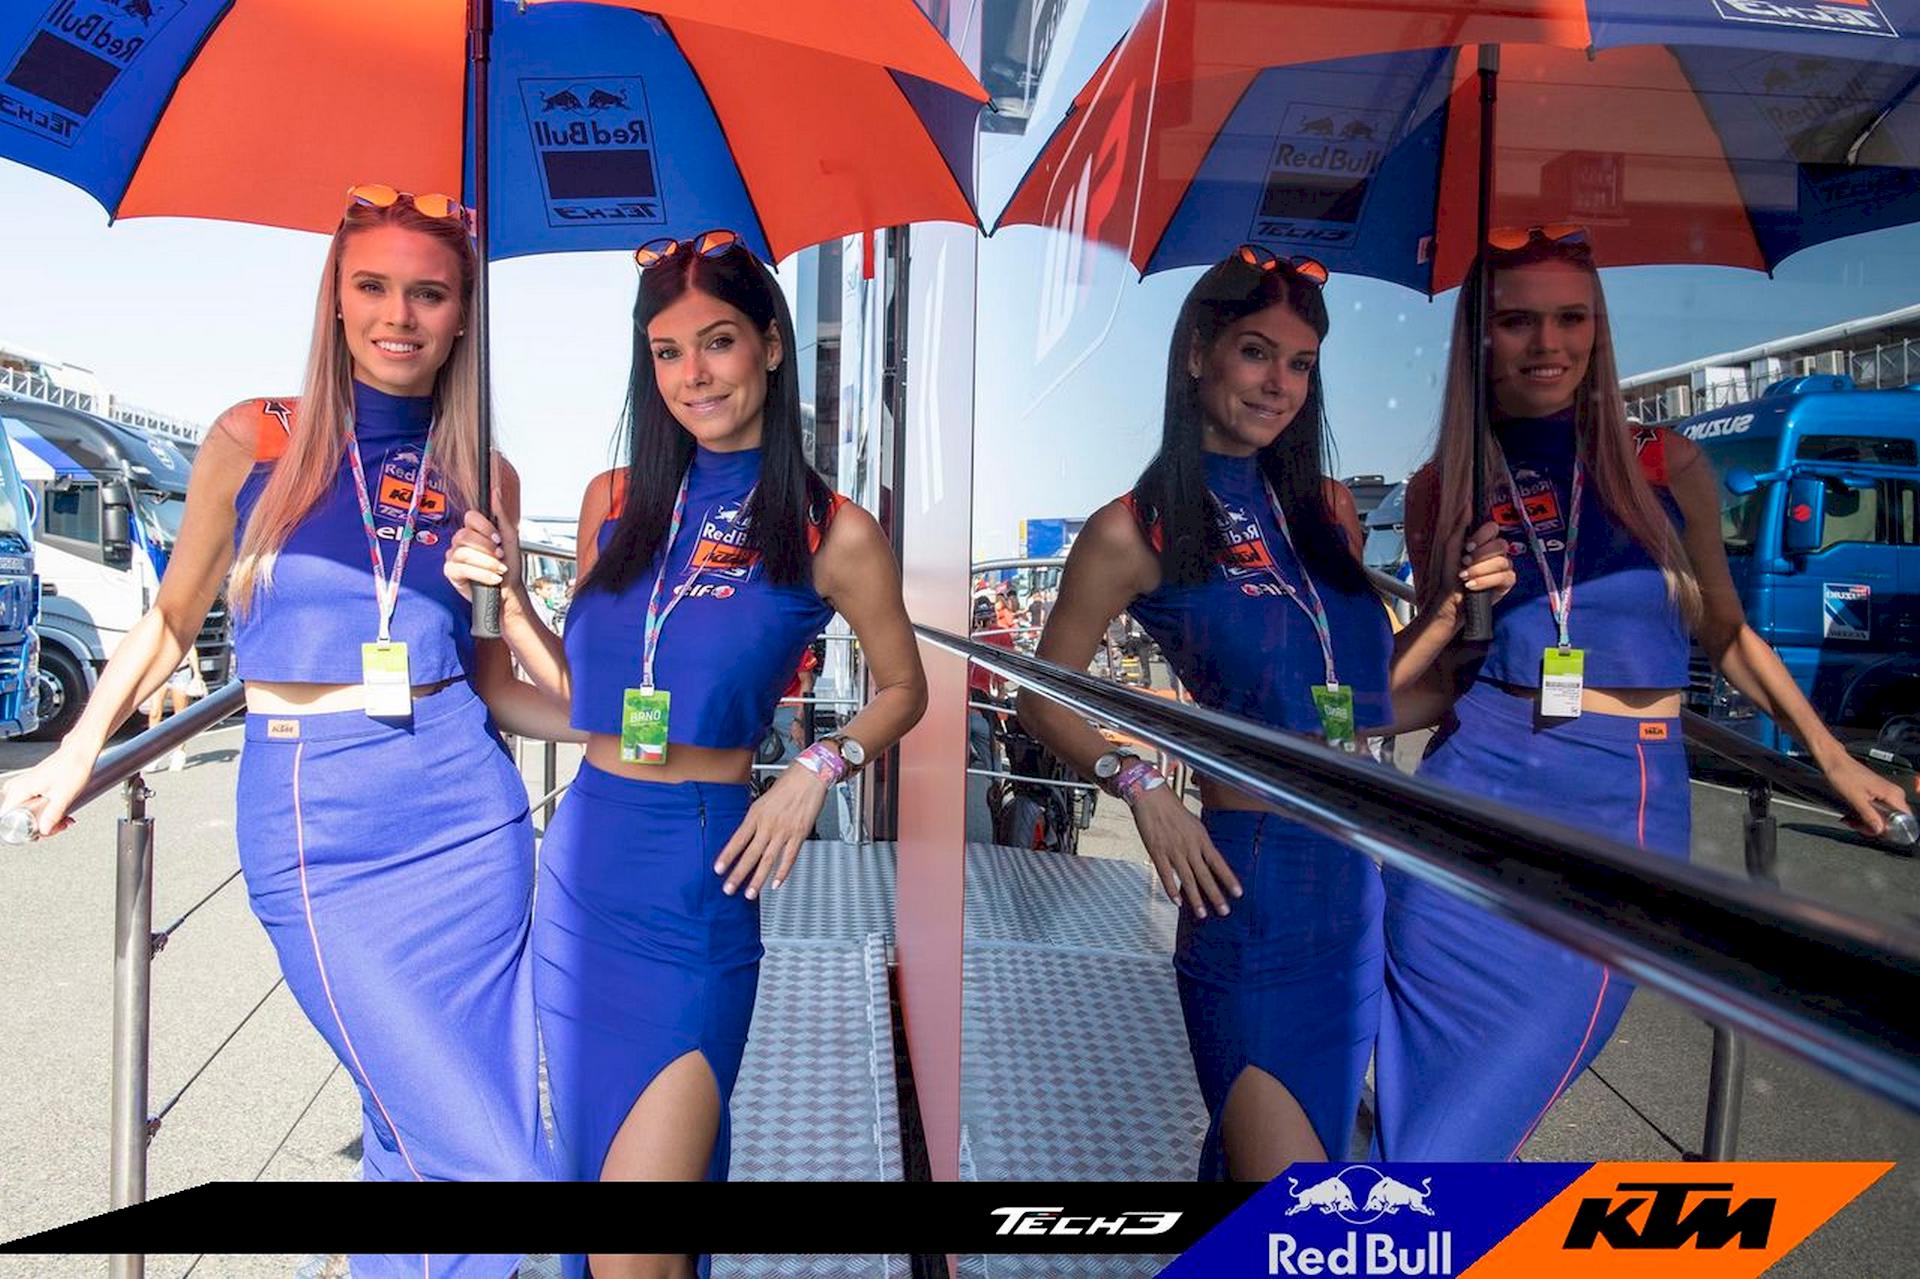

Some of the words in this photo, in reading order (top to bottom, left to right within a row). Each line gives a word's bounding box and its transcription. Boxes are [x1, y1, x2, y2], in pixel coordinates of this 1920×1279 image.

[1275, 143, 1329, 169] Red
[1329, 146, 1382, 174] Bull
[385, 463, 417, 483] Red
[702, 521, 736, 544] Red
[630, 709, 662, 724] BRNO
